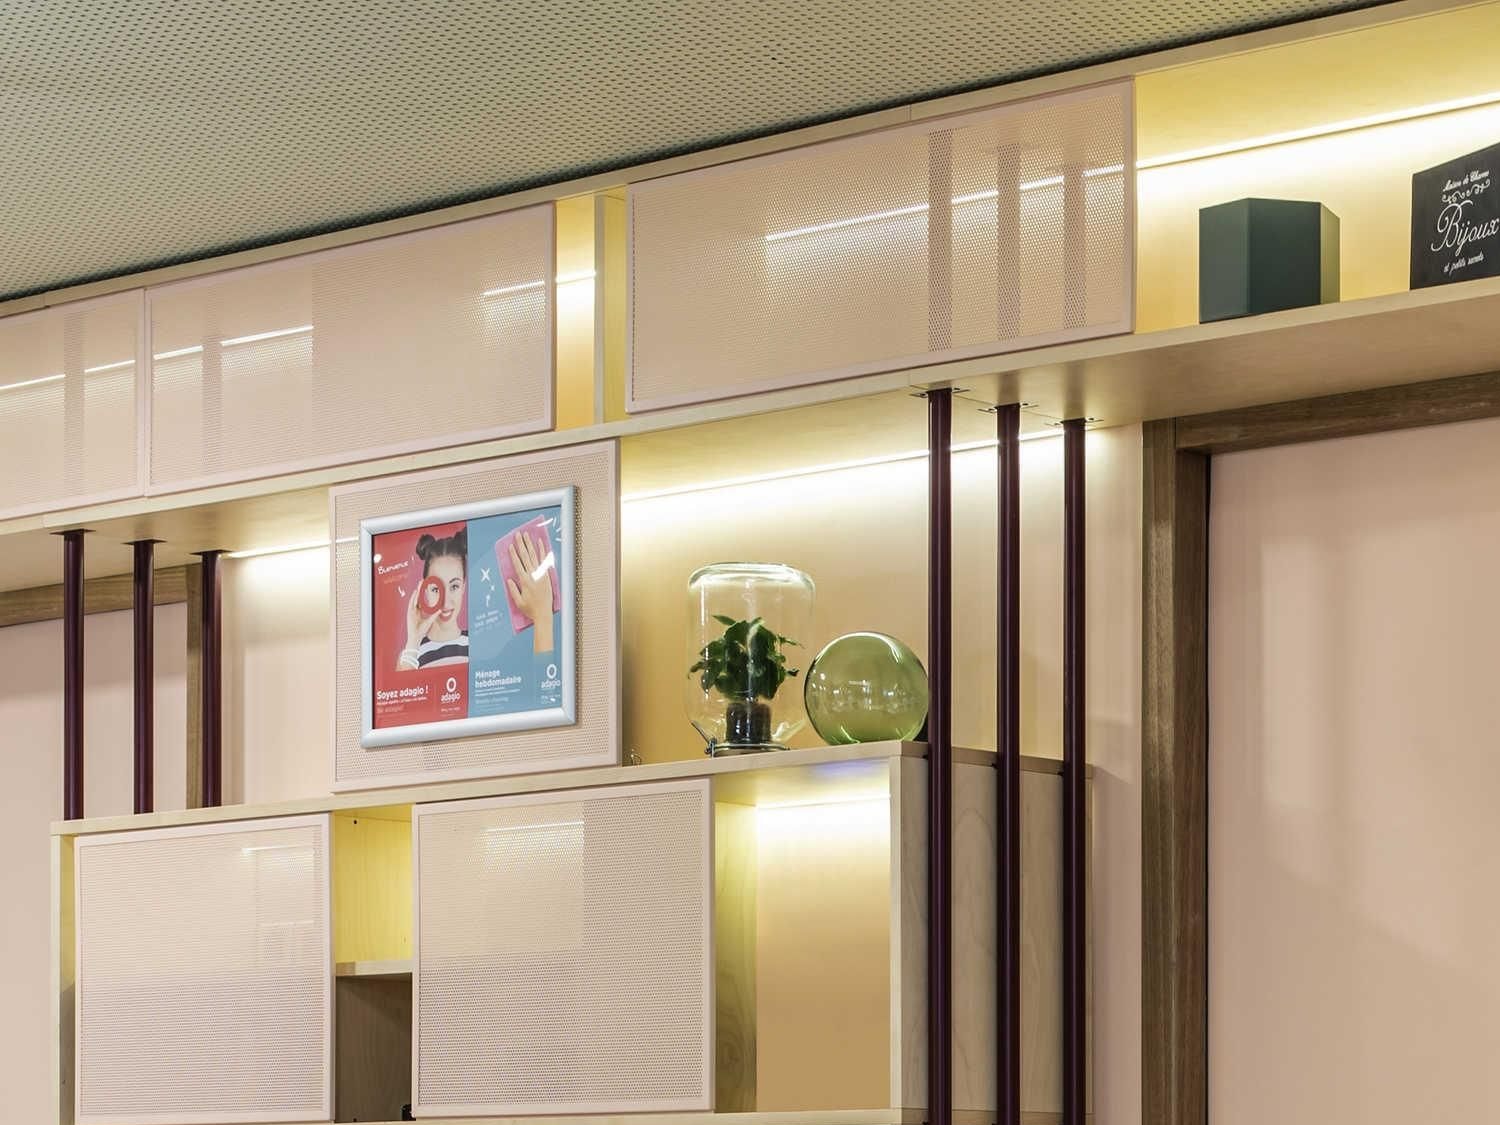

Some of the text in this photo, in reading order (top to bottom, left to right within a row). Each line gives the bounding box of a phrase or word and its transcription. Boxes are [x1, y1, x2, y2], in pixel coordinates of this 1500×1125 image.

[1431, 200, 1499, 256] Bijoux
[475, 670, 500, 679] Ménage
[474, 676, 522, 689] hebdomadaire
[541, 680, 561, 690] adagio
[376, 690, 399, 701] Soyez
[399, 686, 425, 698] adagio
[440, 692, 461, 703] adagio
